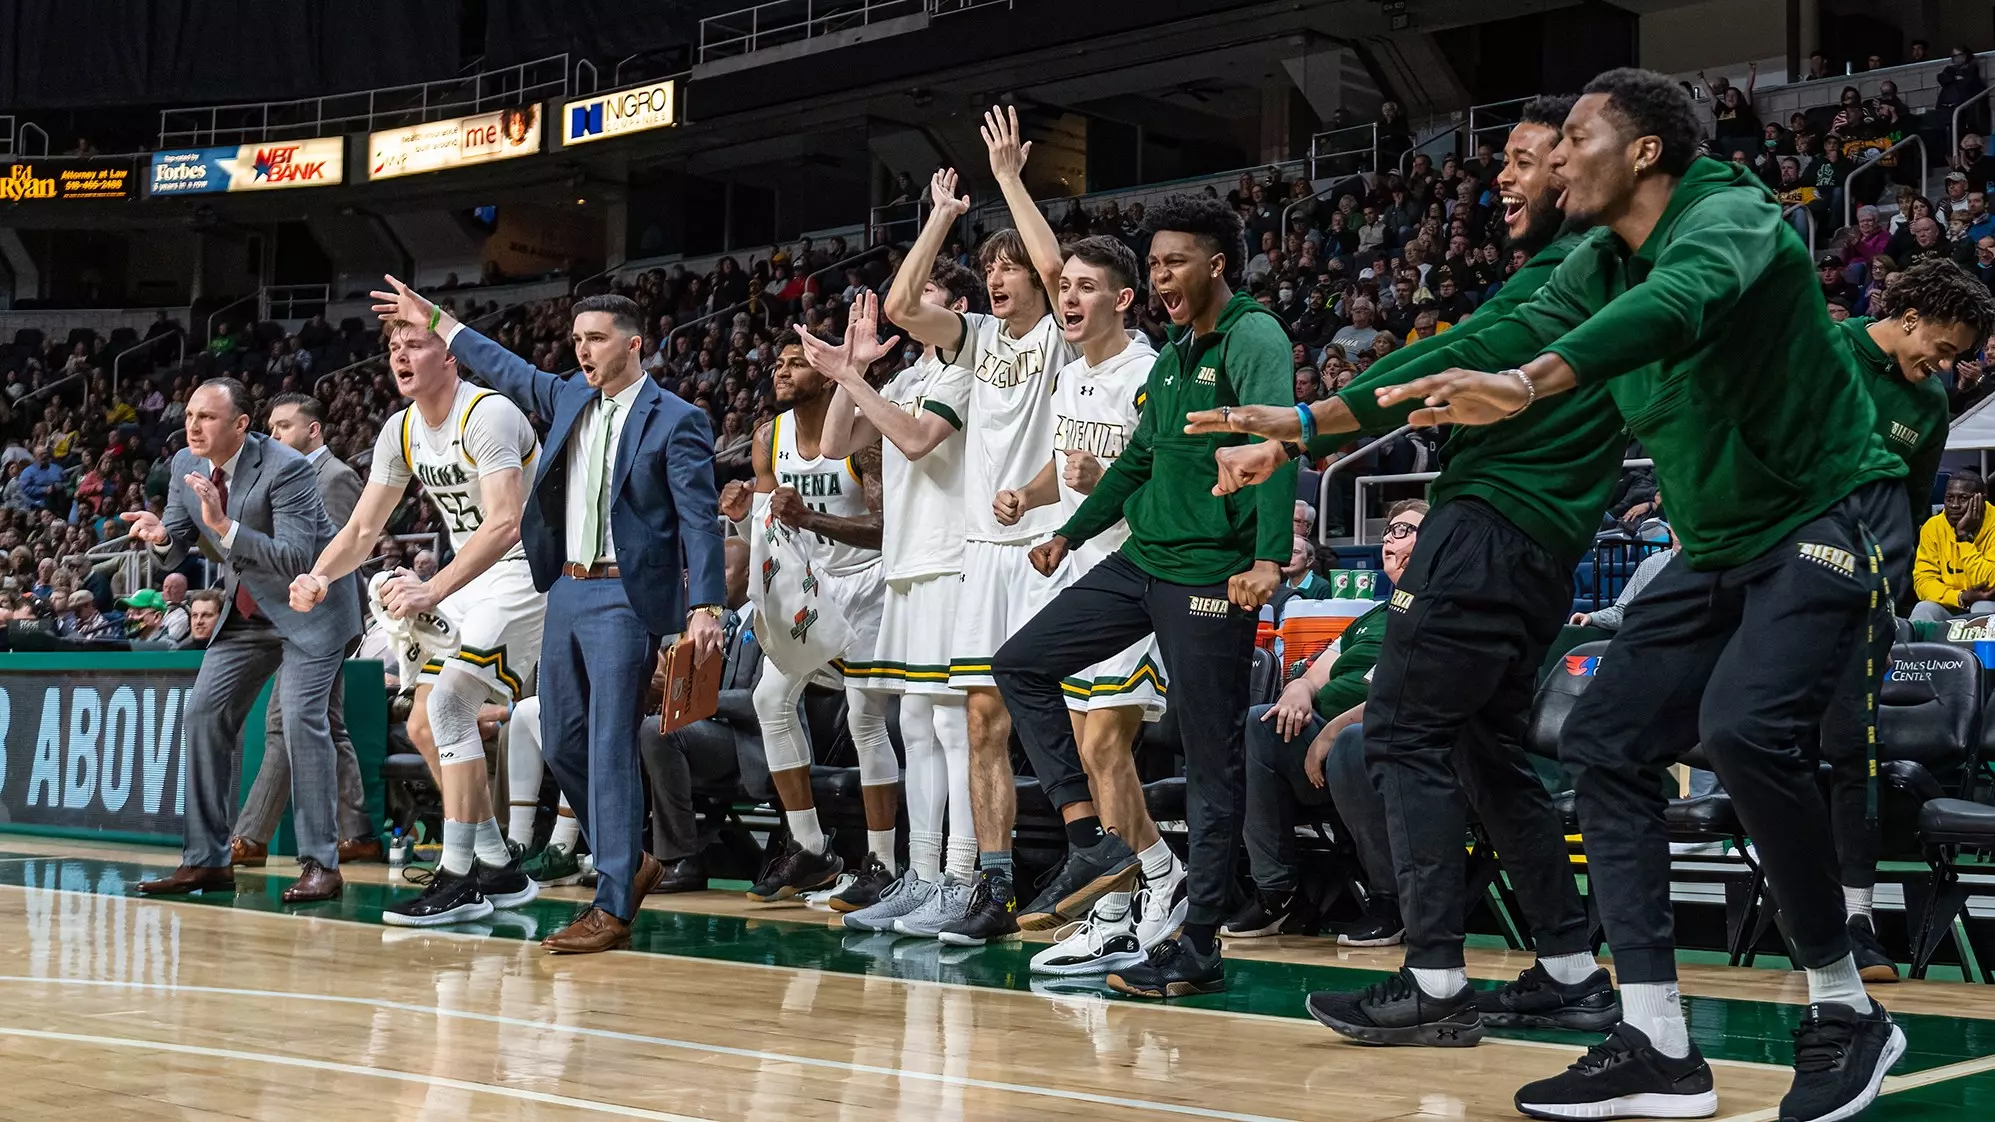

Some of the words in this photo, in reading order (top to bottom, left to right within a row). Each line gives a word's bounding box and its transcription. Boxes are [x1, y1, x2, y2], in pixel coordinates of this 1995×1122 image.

[606, 88, 666, 121] NIGRO
[466, 125, 496, 148] me
[255, 145, 300, 167] NBT
[11, 165, 32, 182] Ed
[60, 170, 97, 180] Attorney
[98, 171, 108, 179] at
[109, 169, 128, 179] Law
[155, 163, 206, 181] Forbes
[266, 161, 327, 182] BANK
[0, 177, 57, 201] Ryan
[975, 342, 1045, 388] SENA
[1054, 414, 1124, 458] SIENA
[1891, 420, 1919, 444] SIENA
[416, 462, 469, 487] SIENA
[433, 491, 484, 533] 55
[1797, 543, 1856, 573] SIENA
[1189, 595, 1229, 613] SIENA
[1891, 671, 1932, 681] CENTER
[1894, 660, 1925, 670] TIMES
[1926, 660, 1963, 670] UNION
